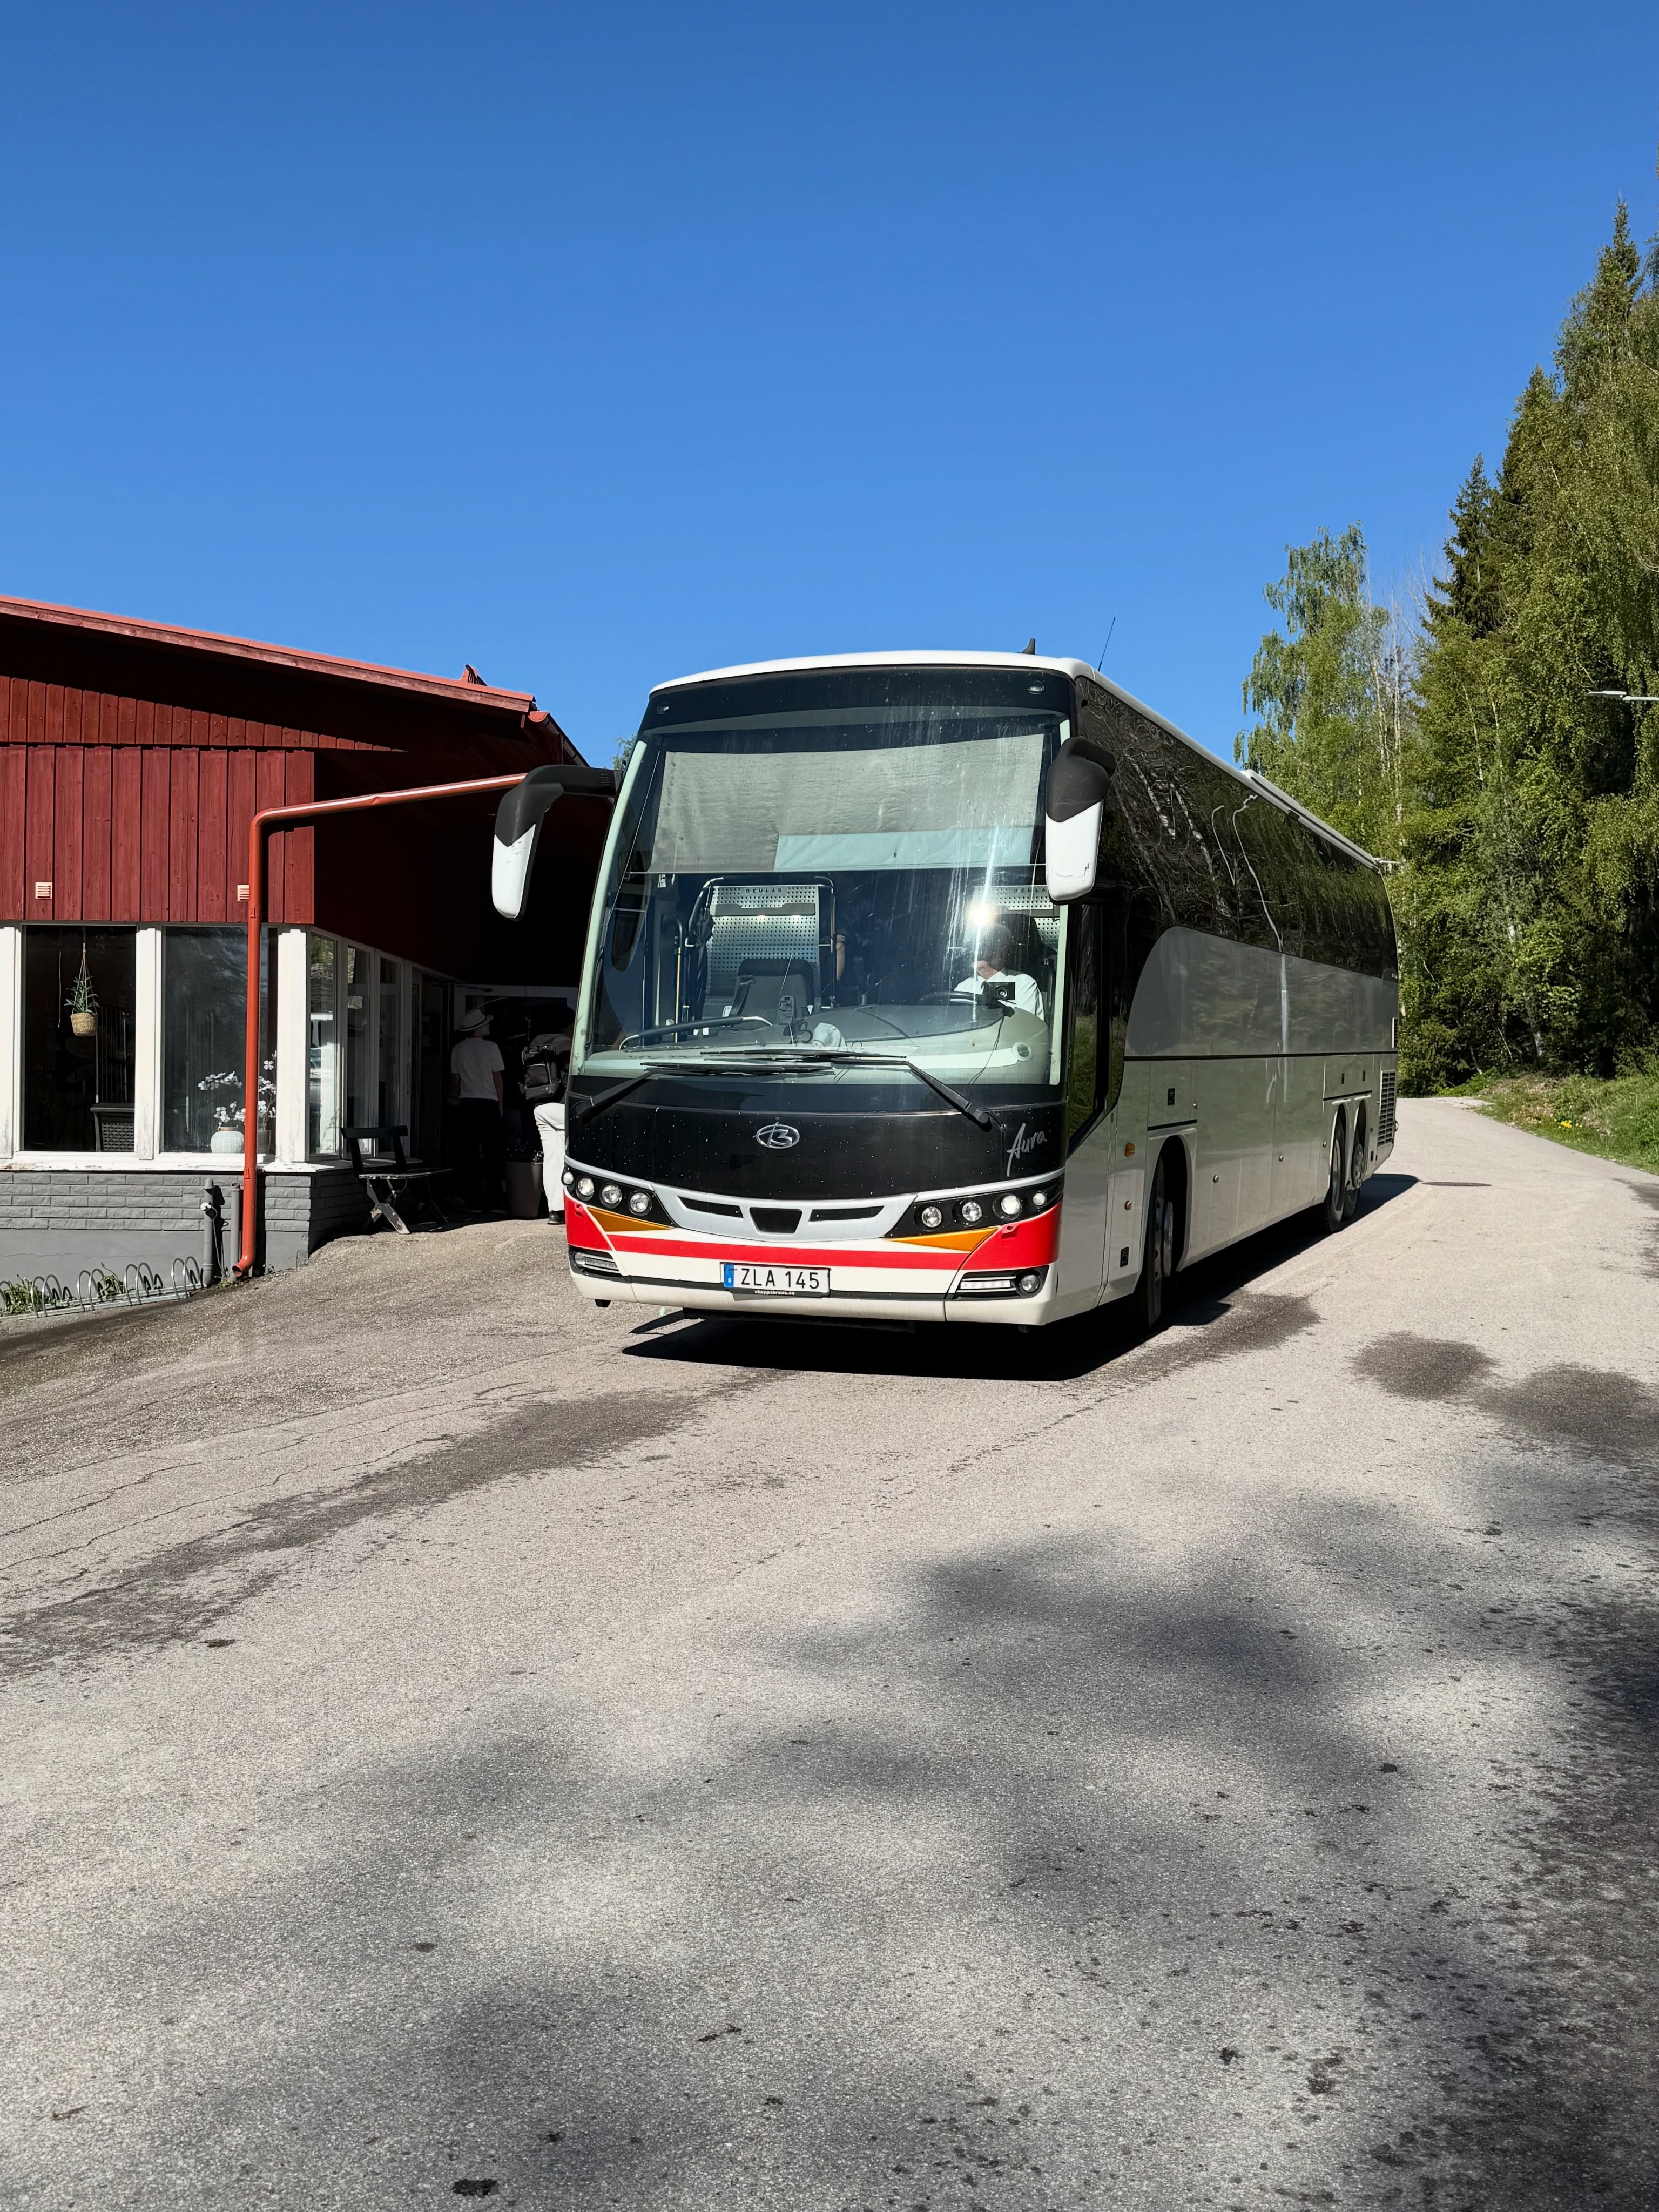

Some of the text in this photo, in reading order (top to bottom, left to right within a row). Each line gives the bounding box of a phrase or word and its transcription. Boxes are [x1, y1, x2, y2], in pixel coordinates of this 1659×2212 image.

[1006, 1123, 1048, 1177] Aura
[741, 1268, 820, 1290] ZLA 145
